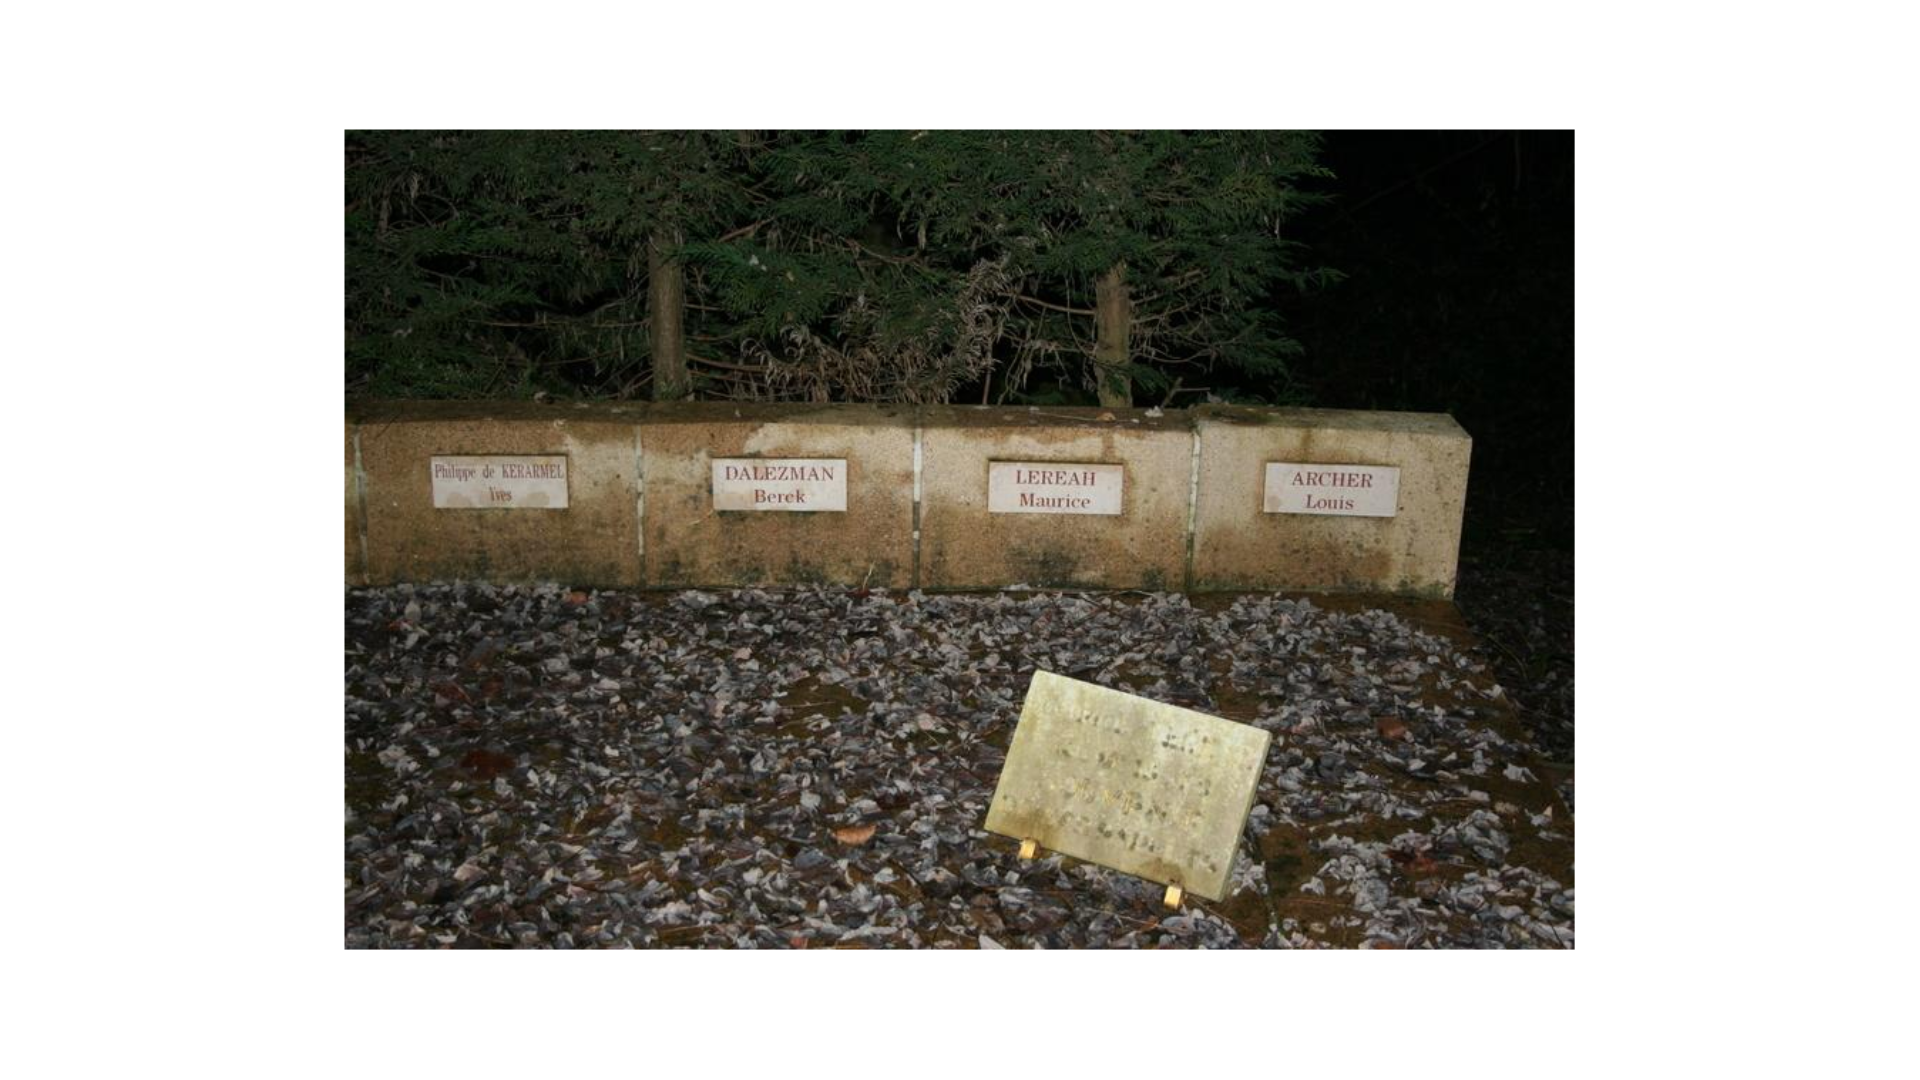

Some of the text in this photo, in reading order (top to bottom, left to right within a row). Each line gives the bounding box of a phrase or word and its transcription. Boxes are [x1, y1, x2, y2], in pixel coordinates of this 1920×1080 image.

[434, 463, 565, 481] Philippe de KERARMEL
[725, 465, 835, 481] DALEZMAN
[1015, 469, 1096, 486] LEREAH
[1292, 470, 1374, 488] ARCHER
[489, 486, 512, 501] Yves
[1019, 492, 1091, 508] Maurice
[1306, 494, 1355, 510] Louis
